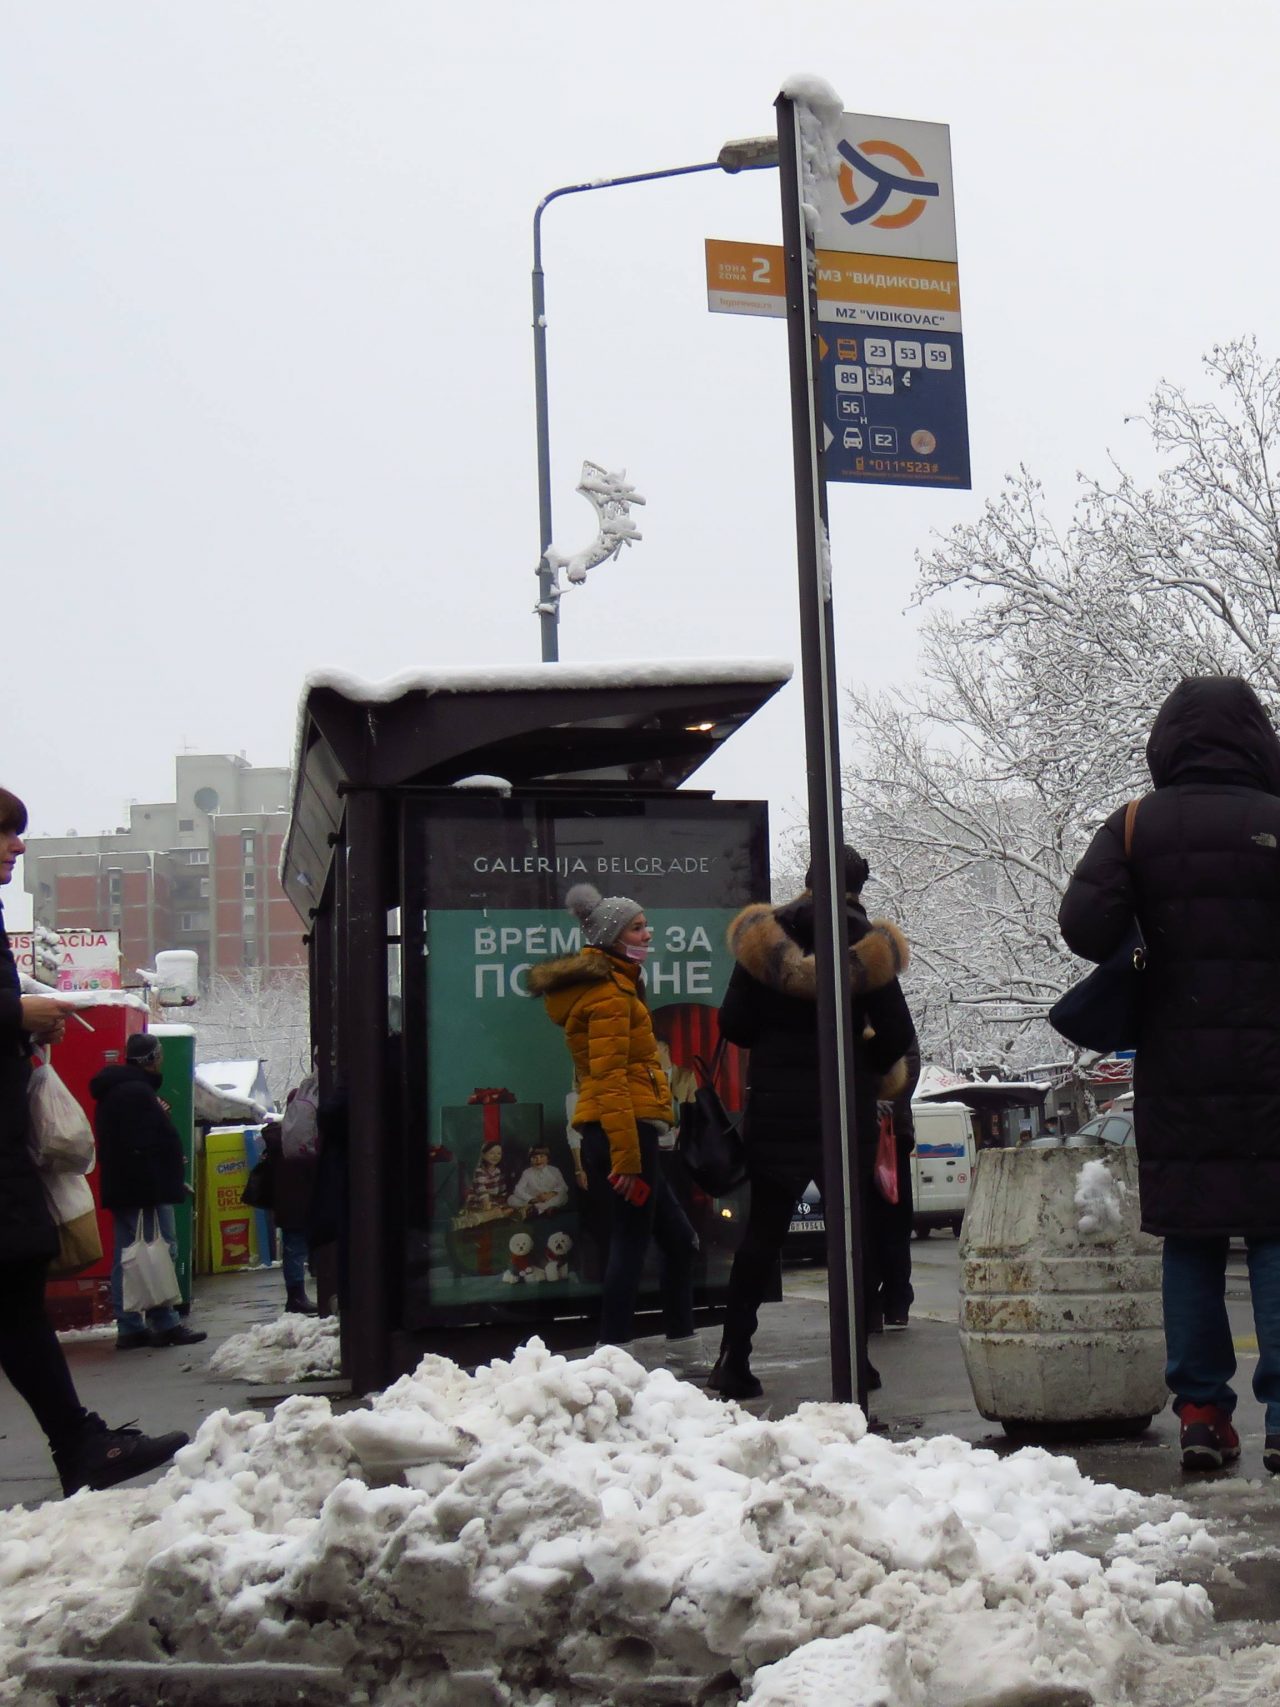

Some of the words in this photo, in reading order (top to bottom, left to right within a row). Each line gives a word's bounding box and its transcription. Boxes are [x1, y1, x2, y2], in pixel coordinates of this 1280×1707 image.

[719, 272, 747, 281] ZONA
[752, 257, 771, 283] 2
[818, 269, 842, 282] МЗ
[846, 271, 957, 294] "ВИДИКОВАЦ"
[835, 307, 857, 319] MZ
[860, 310, 945, 326] "VIDIKOVAC"
[870, 345, 886, 357] 23
[900, 348, 916, 360] 53
[930, 350, 946, 362] 59
[841, 372, 858, 384] 89
[868, 373, 892, 386] 534
[842, 401, 860, 414] 56
[875, 434, 893, 447] E2
[473, 857, 588, 877] GALERIJA
[598, 857, 710, 876] BELGRADE
[475, 926, 591, 955] ВРЕМ
[665, 926, 713, 952] ЗА
